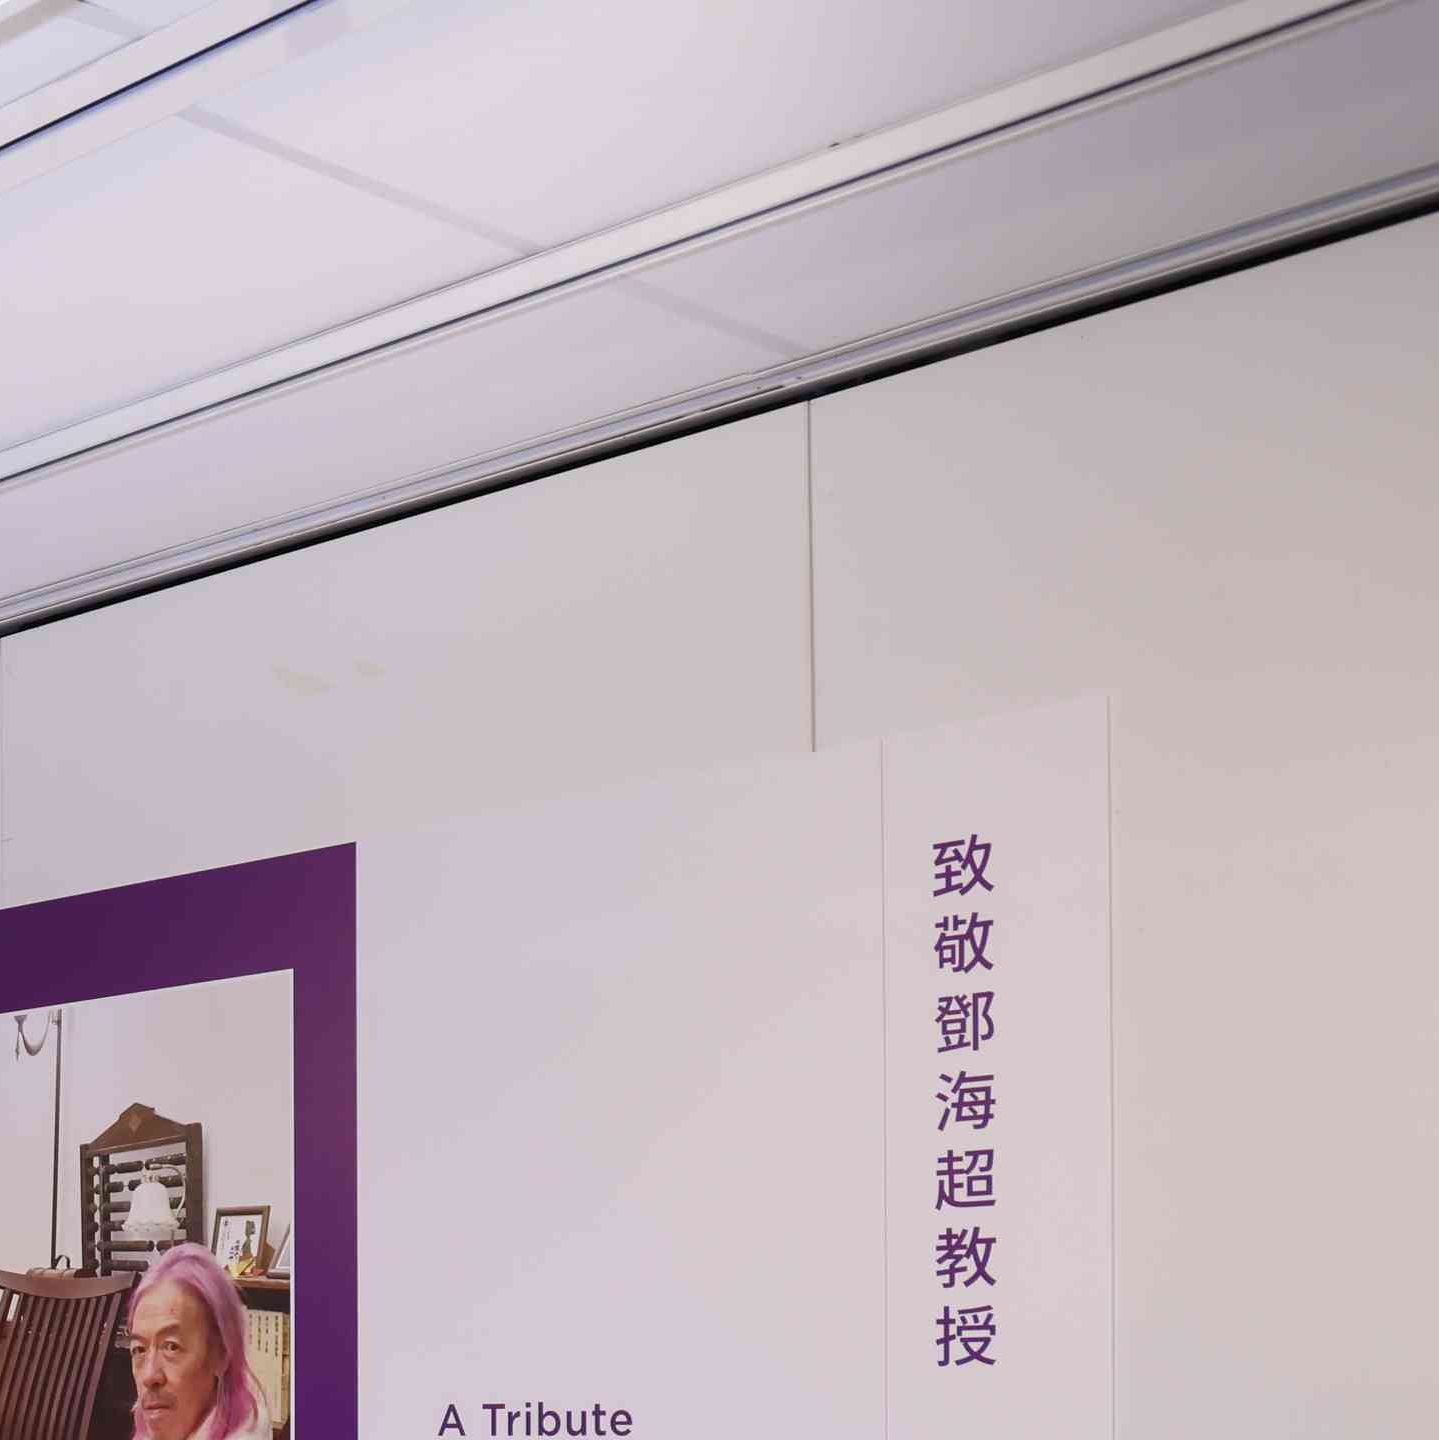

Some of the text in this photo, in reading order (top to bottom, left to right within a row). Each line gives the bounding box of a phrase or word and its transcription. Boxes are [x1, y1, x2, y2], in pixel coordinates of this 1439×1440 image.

[932, 833, 997, 1367] 致敬鄧海超教授
[437, 1401, 633, 1437] A Tribute
